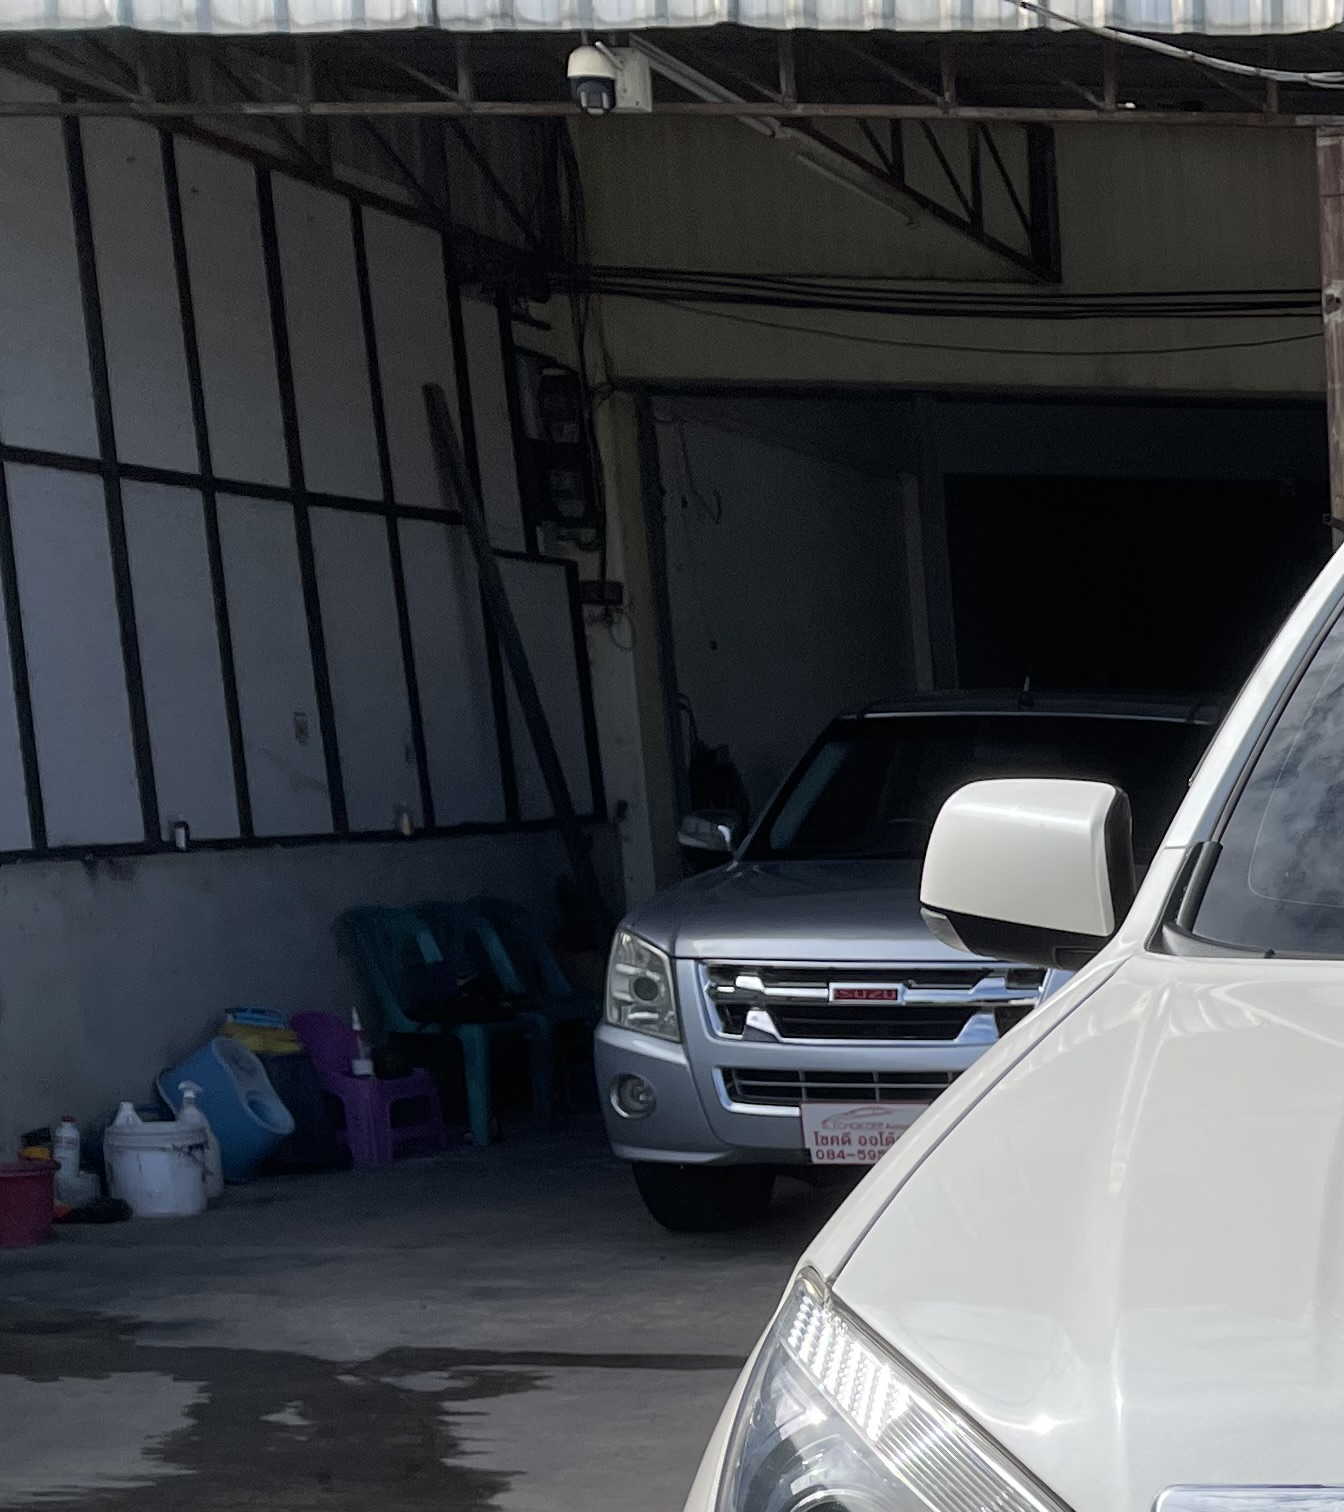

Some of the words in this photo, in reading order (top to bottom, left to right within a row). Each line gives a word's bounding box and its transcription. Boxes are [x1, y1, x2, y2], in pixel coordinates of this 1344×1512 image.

[814, 1131, 852, 1147] โชคดี
[858, 1131, 896, 1147] ออโต้
[815, 1149, 885, 1161] 084-59
